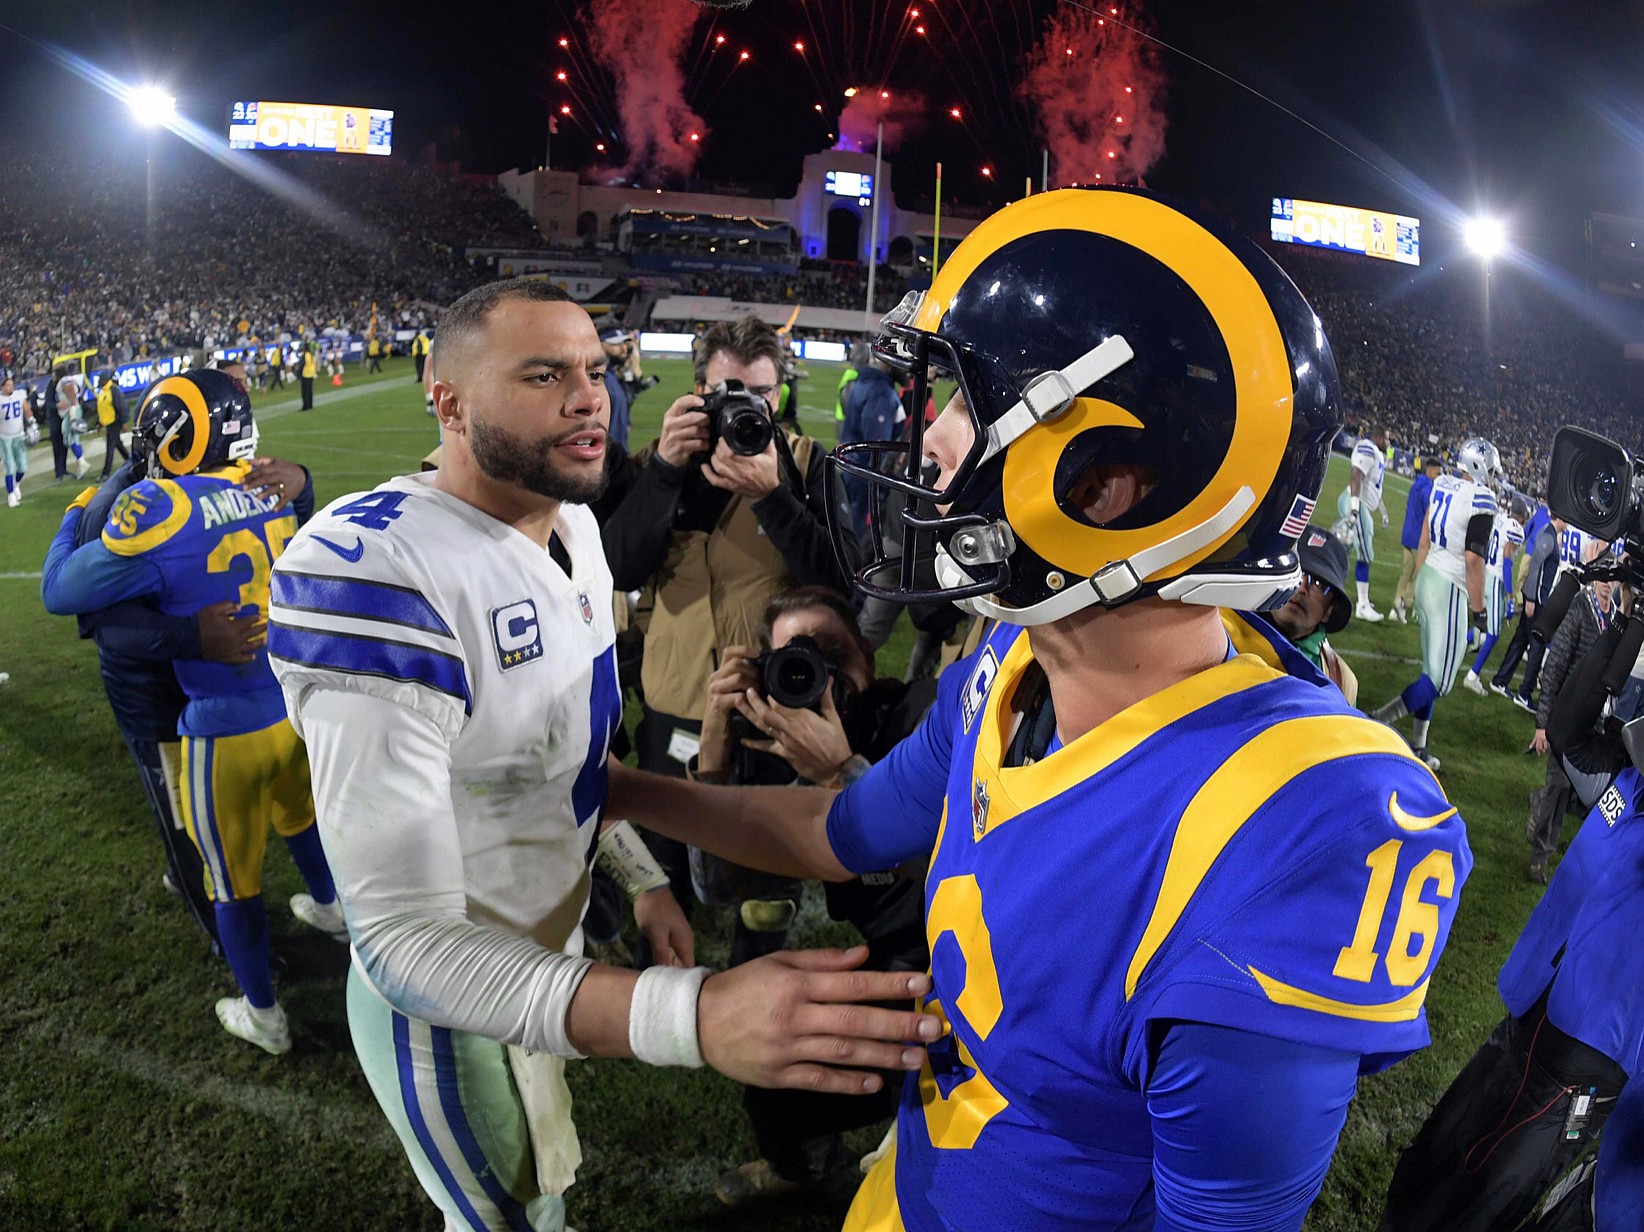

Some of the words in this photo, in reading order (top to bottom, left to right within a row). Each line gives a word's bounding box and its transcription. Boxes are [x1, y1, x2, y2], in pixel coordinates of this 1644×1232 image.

[258, 116, 339, 149] ONE
[1295, 213, 1366, 252] ONE
[2, 400, 21, 421] 76
[331, 491, 413, 531] 4
[1430, 490, 1453, 548] 71
[1561, 529, 1581, 565] 89
[496, 600, 538, 651] C
[969, 653, 996, 712] C
[1601, 790, 1623, 821] SDS
[1332, 839, 1456, 987] 16
